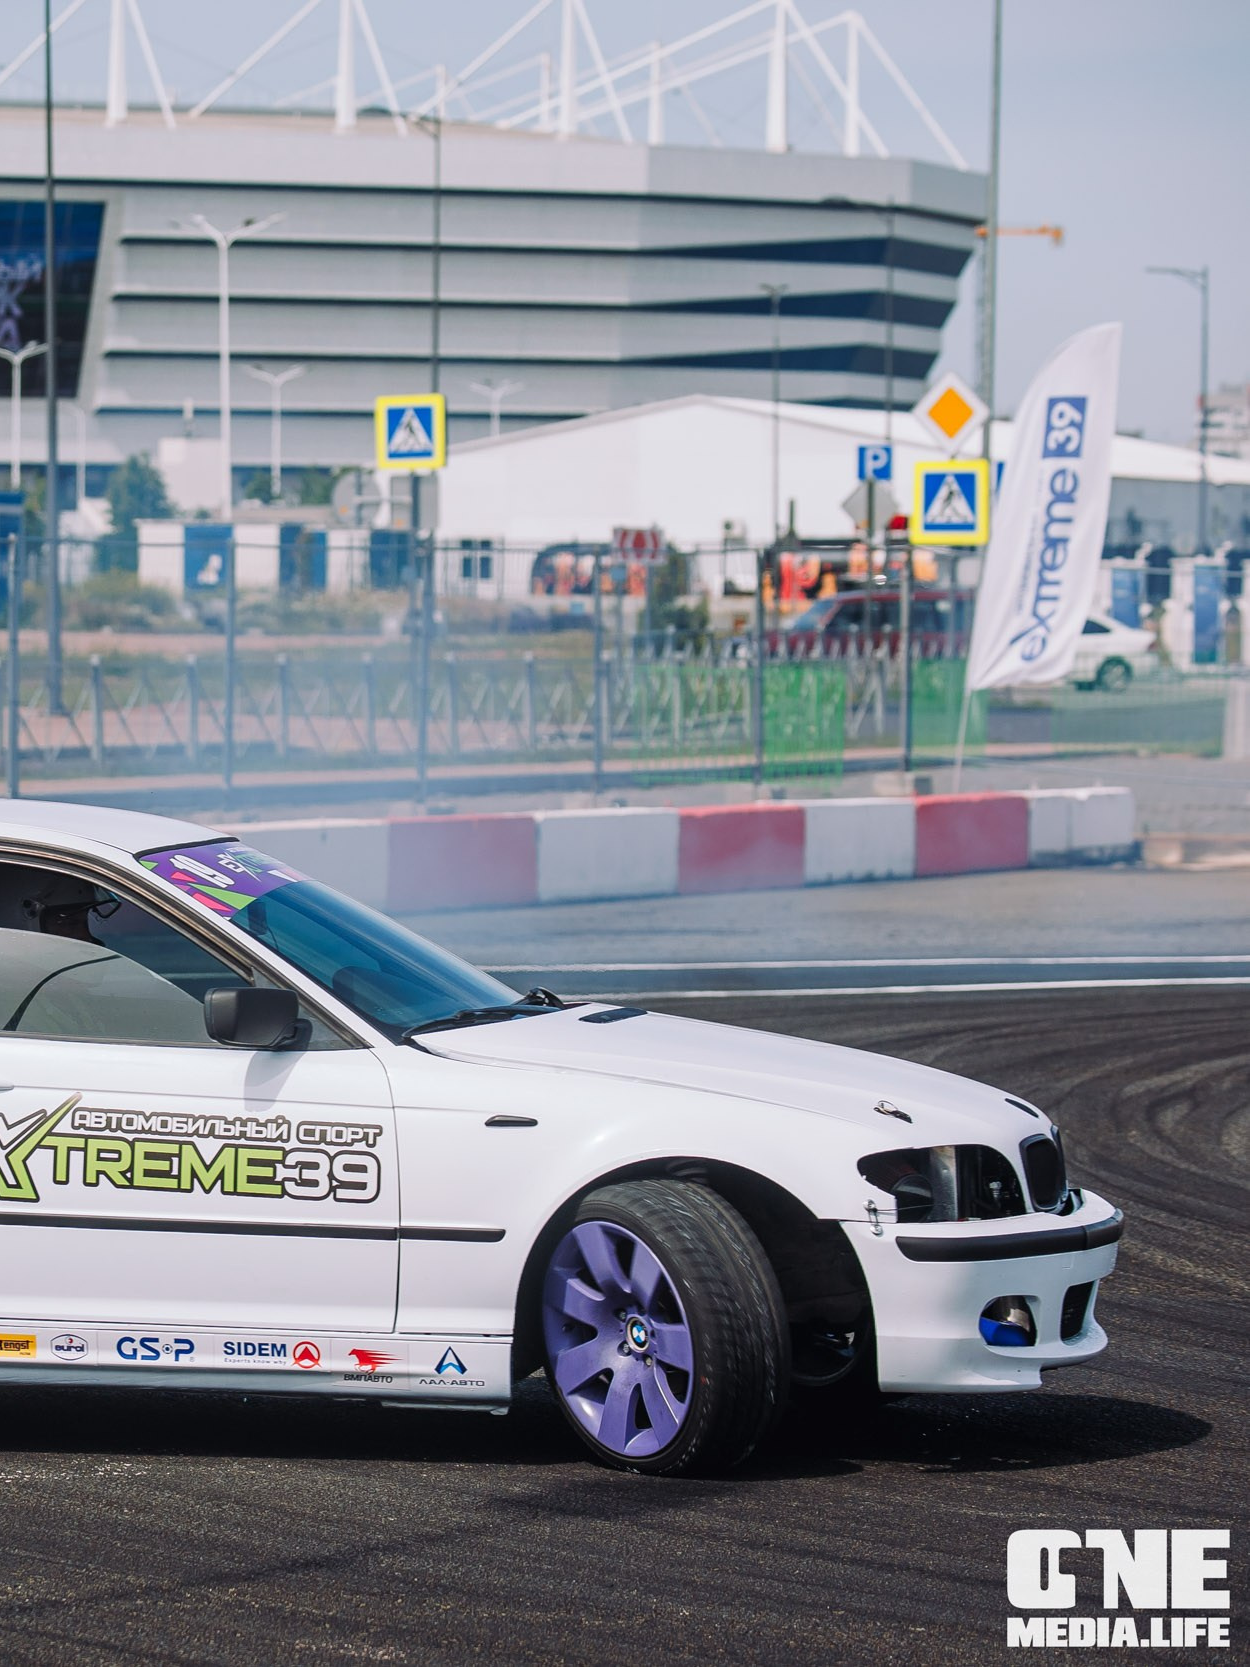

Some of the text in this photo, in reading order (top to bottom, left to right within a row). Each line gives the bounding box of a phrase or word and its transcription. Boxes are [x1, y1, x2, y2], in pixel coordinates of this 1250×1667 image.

[1046, 401, 1083, 454] 39
[864, 447, 888, 480] P
[72, 1109, 383, 1147] АВТОМОБИЛЬНЫЙ СПОРТ
[223, 1341, 288, 1358] SIDEM
[344, 1373, 393, 1384] ВМПАВТО
